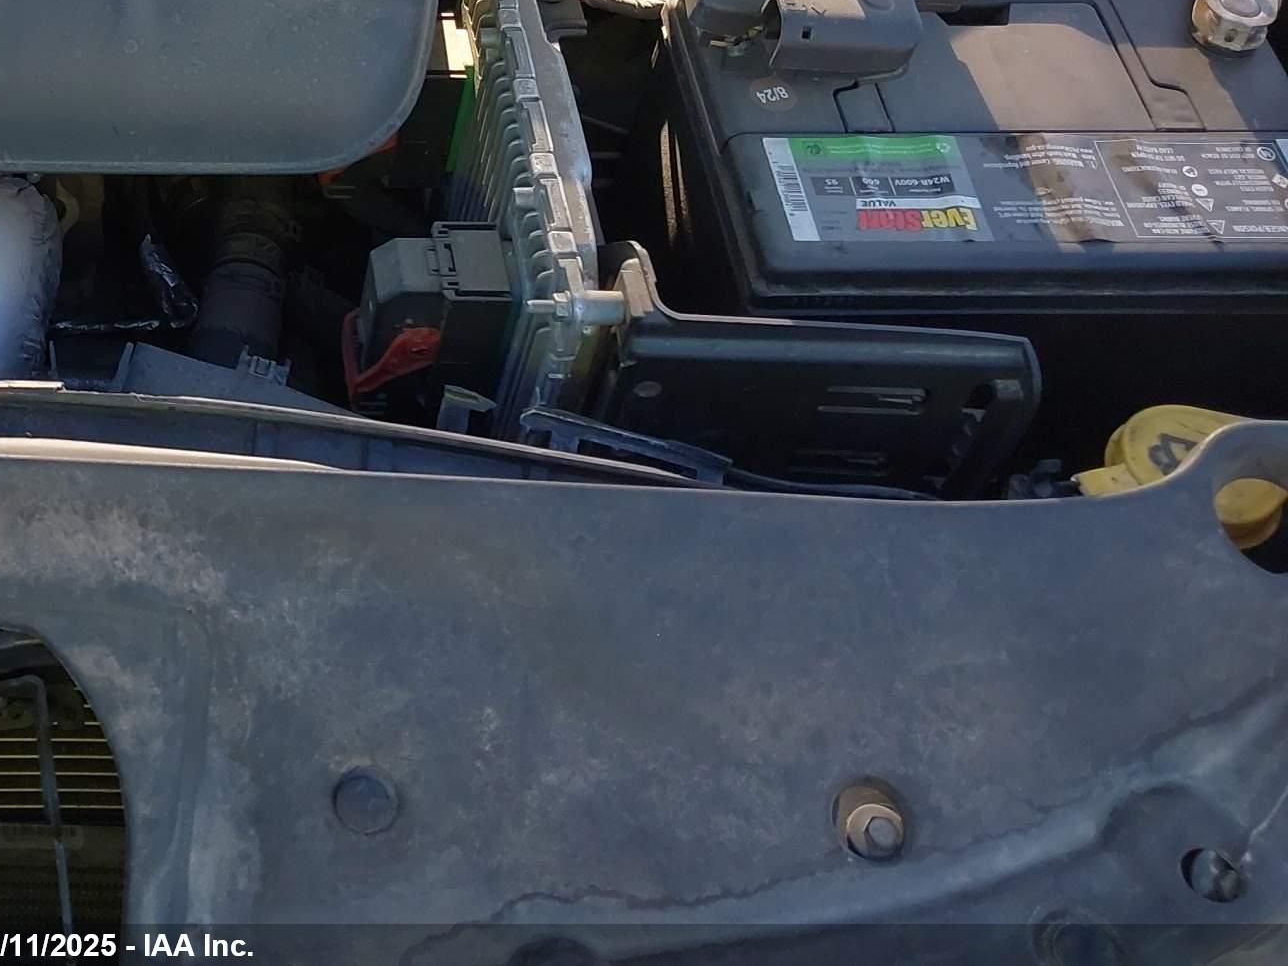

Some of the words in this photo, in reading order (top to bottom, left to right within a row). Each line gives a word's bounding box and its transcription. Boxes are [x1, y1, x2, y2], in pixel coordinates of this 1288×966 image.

[756, 87, 789, 103] 8/24
[860, 200, 896, 208] VALUE
[859, 207, 979, 231] EverStart
